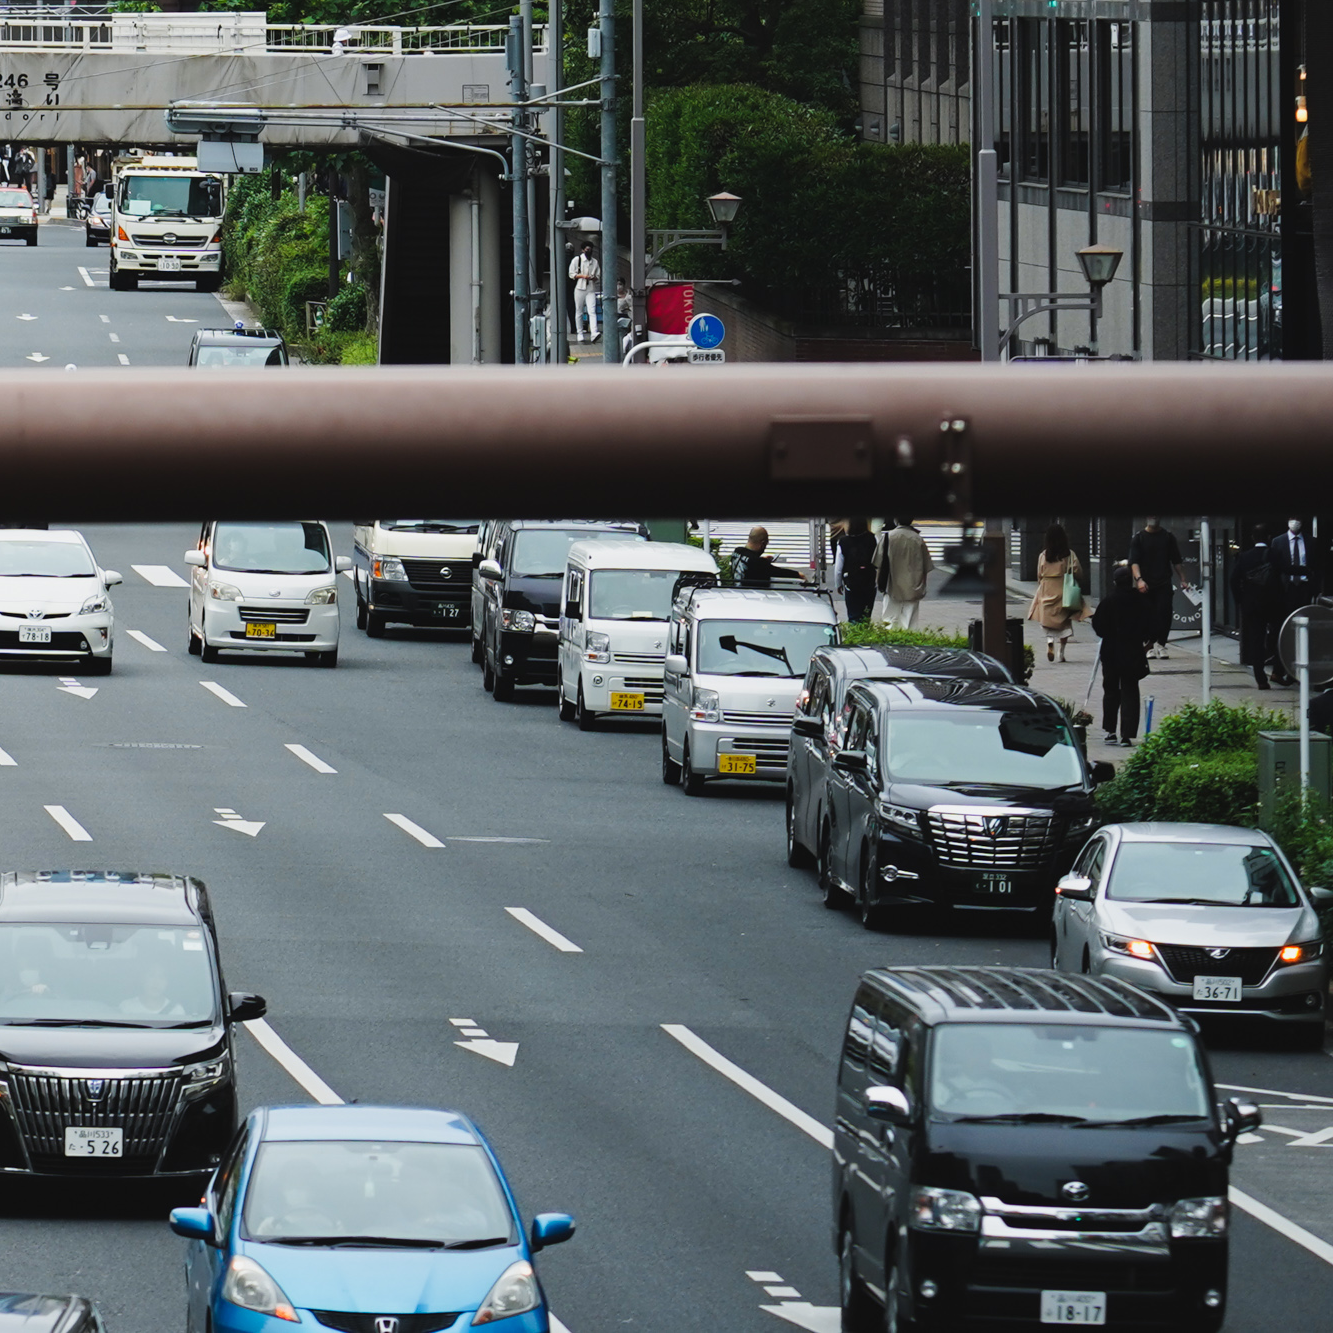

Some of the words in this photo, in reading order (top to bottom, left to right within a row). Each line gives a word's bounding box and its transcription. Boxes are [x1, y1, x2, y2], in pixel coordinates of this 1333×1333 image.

[618, 700, 643, 709] 74-19
[728, 762, 754, 772] 31-75
[1204, 987, 1238, 999] 36-71
[1056, 1304, 1102, 1320] 18-17
